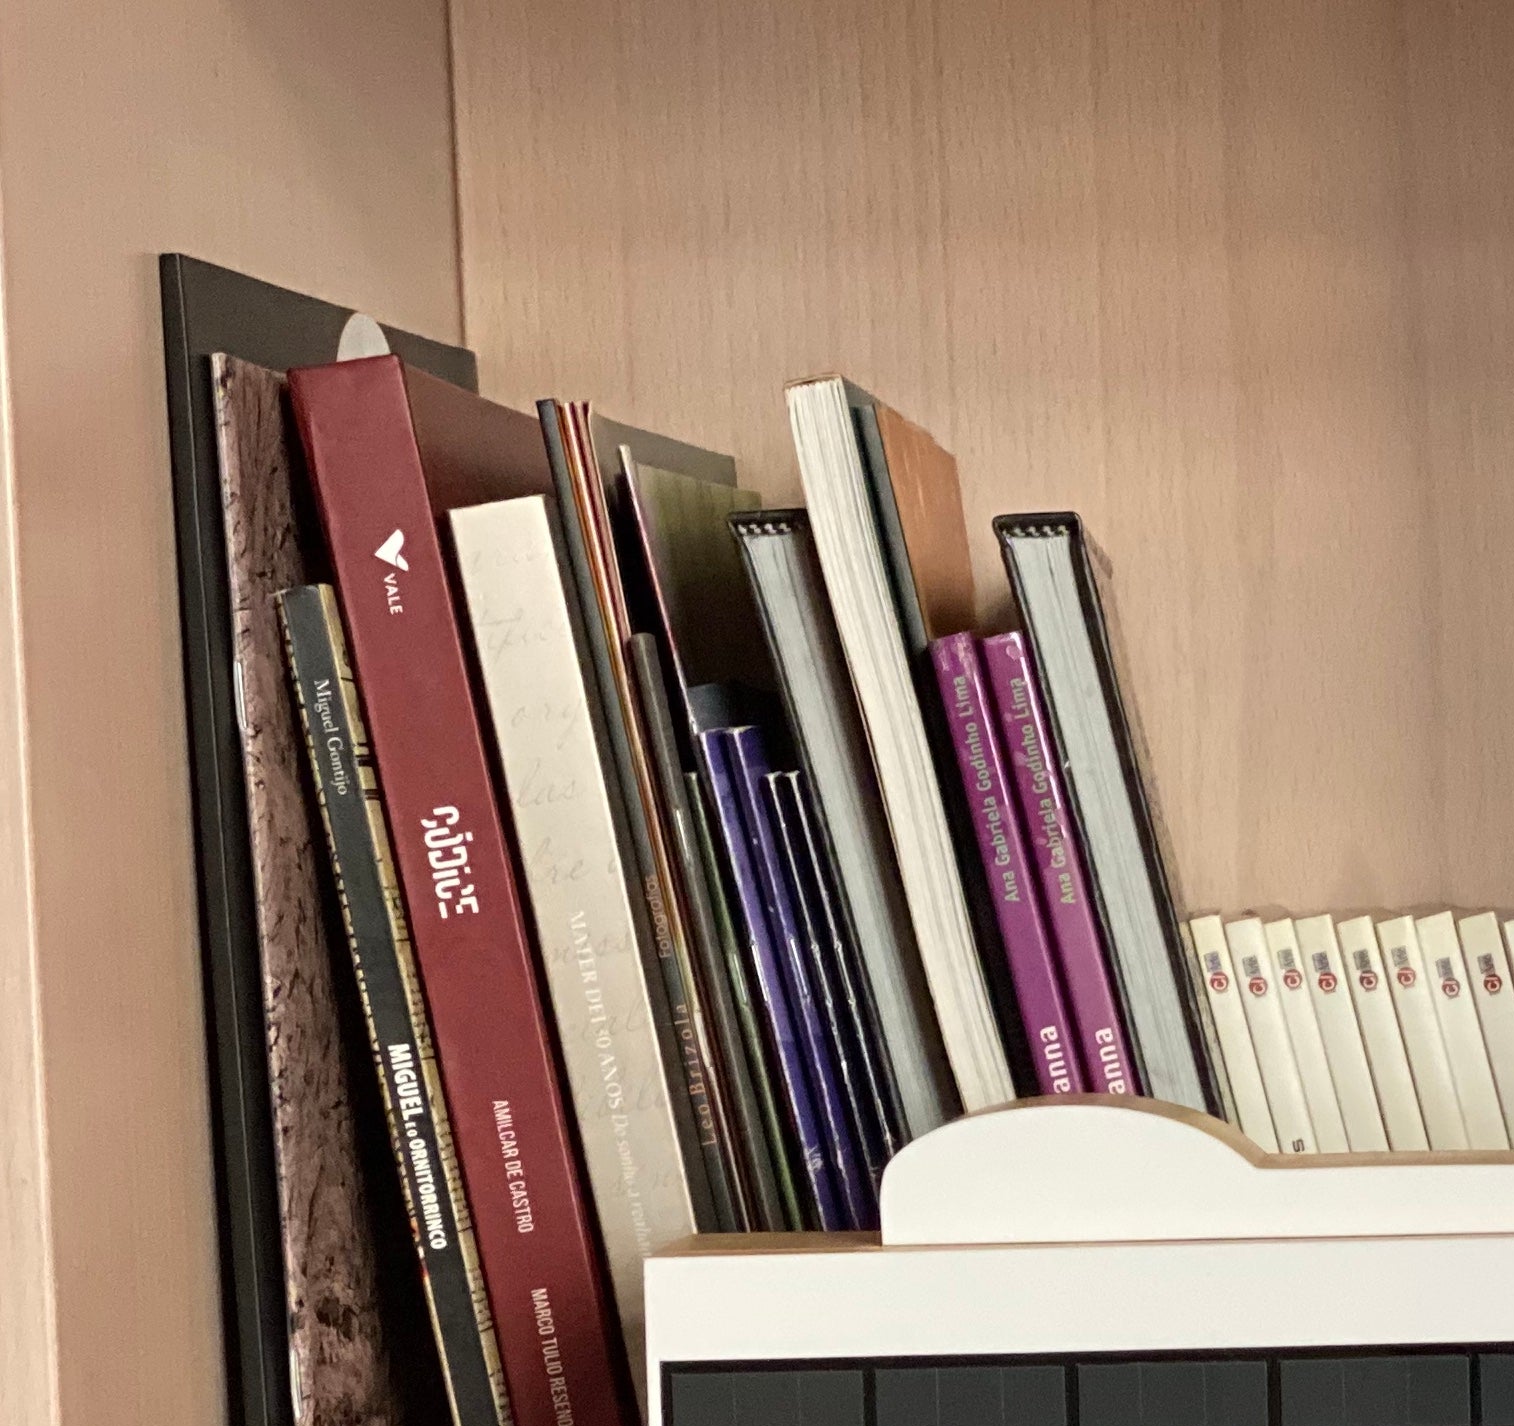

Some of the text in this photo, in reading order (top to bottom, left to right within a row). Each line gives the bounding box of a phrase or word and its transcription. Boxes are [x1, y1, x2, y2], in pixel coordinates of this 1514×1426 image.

[384, 572, 403, 616] VALE
[313, 678, 350, 796] Miguel Gontijo
[953, 675, 1020, 903] Ana Gabriela Godinho Lima
[1010, 677, 1076, 904] Ana Gabriela Godinho Lima
[570, 910, 597, 984] MATER
[585, 988, 606, 1023] DEI
[598, 1053, 625, 1110] ANOS
[1040, 1025, 1071, 1094] anna
[1095, 1027, 1125, 1095] anna
[674, 1004, 717, 1146] Leo Brizola
[387, 1043, 424, 1122] MIGUEL
[409, 1138, 448, 1250] ORNITORRINCO
[492, 1100, 534, 1234] AMILCAR DE CASTRO
[531, 1287, 555, 1336] MARCO
[542, 1337, 563, 1375] TULIO
